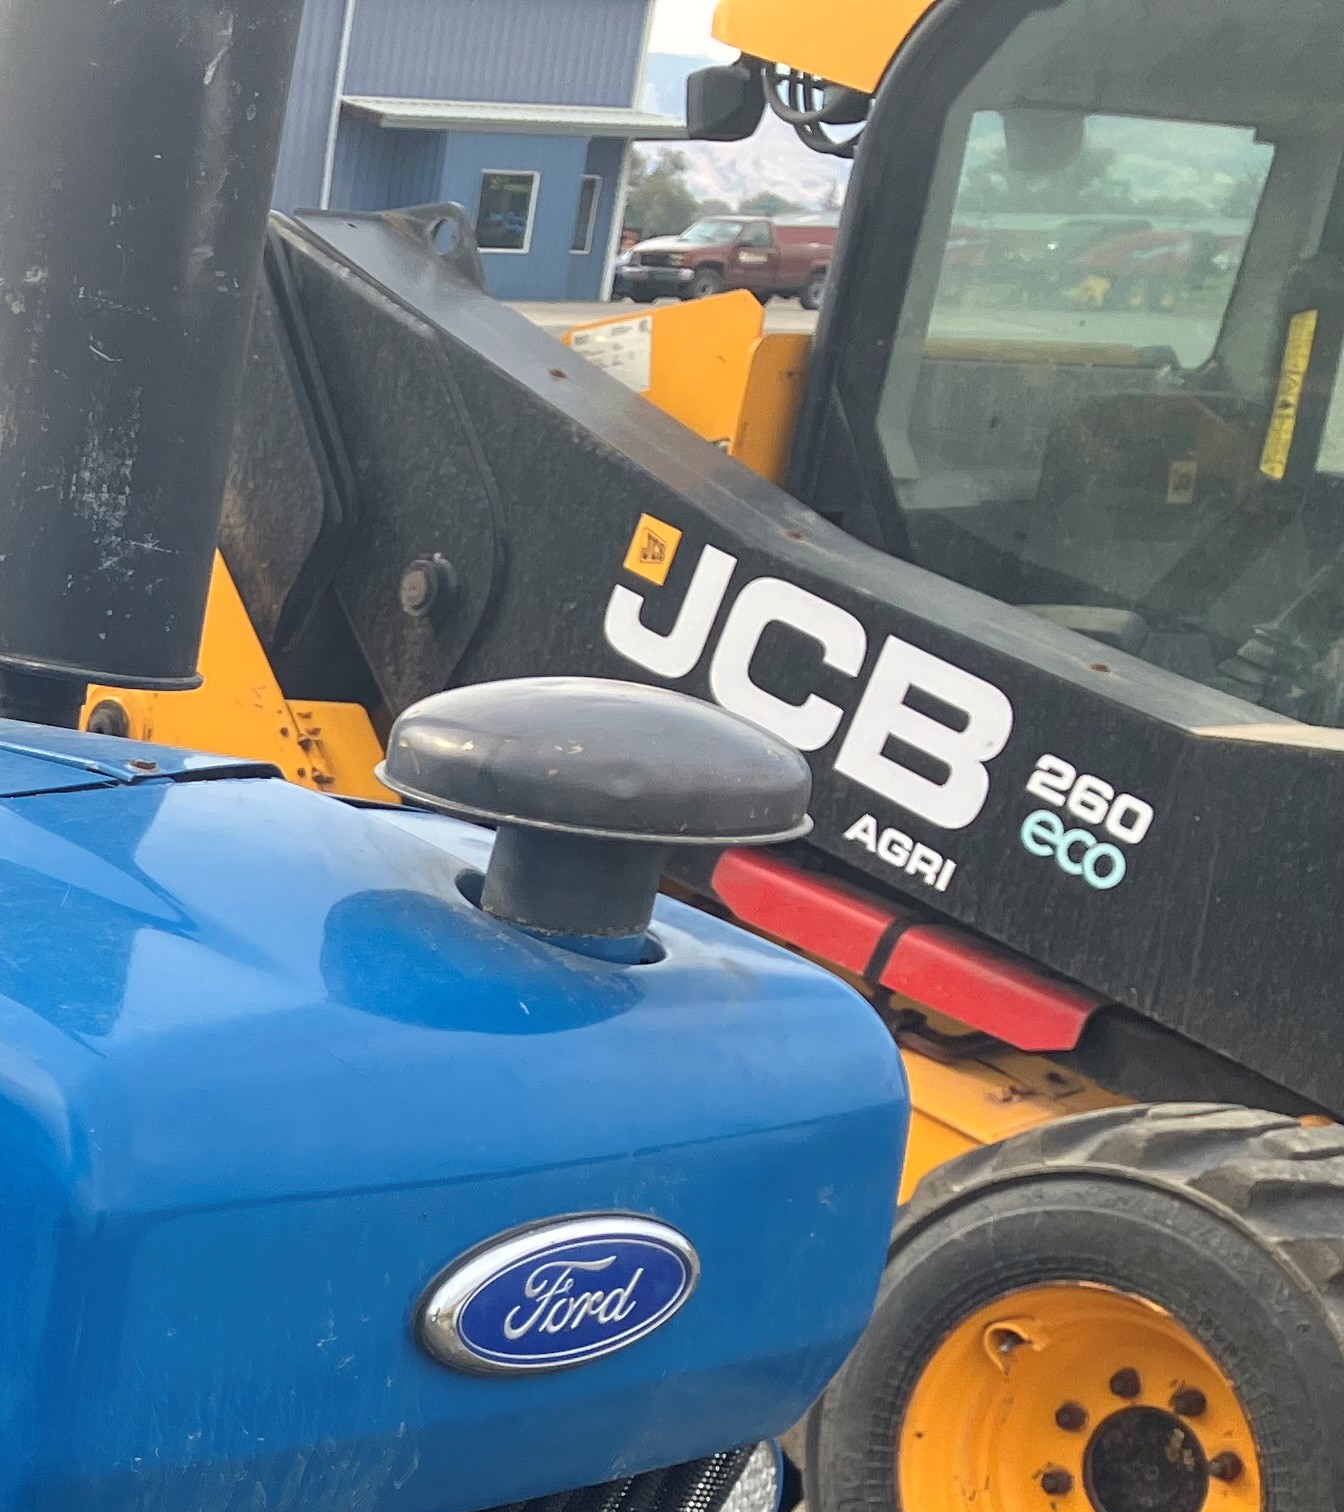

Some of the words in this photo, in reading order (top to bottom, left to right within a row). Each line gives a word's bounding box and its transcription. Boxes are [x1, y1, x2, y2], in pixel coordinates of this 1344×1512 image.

[604, 544, 1014, 830] JCB
[1026, 754, 1155, 844] 260
[843, 815, 957, 891] AGRI
[1021, 810, 1127, 890] eco
[503, 1255, 644, 1340] Ford
